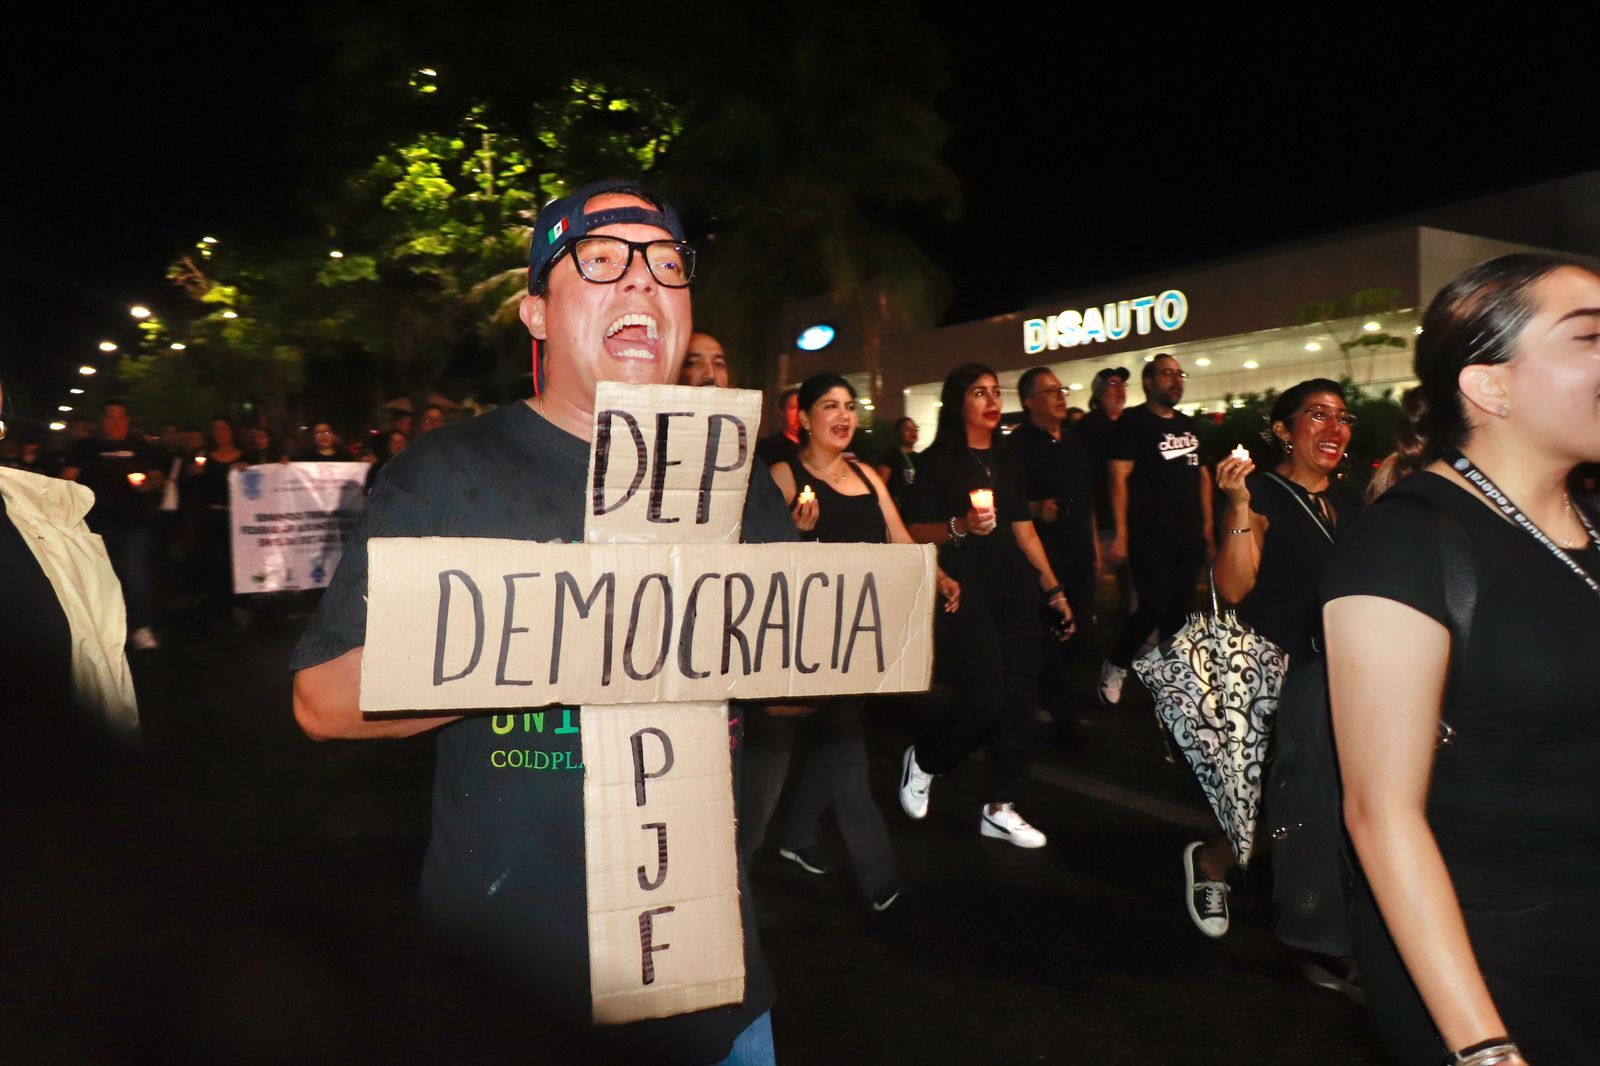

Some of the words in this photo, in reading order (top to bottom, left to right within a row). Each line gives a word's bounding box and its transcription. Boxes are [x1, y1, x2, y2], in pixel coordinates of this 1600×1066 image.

[1023, 289, 1189, 355] DISAUTO
[592, 409, 748, 525] DEP
[1465, 469, 1516, 514] Federal
[432, 568, 885, 687] DEMOCRACIA
